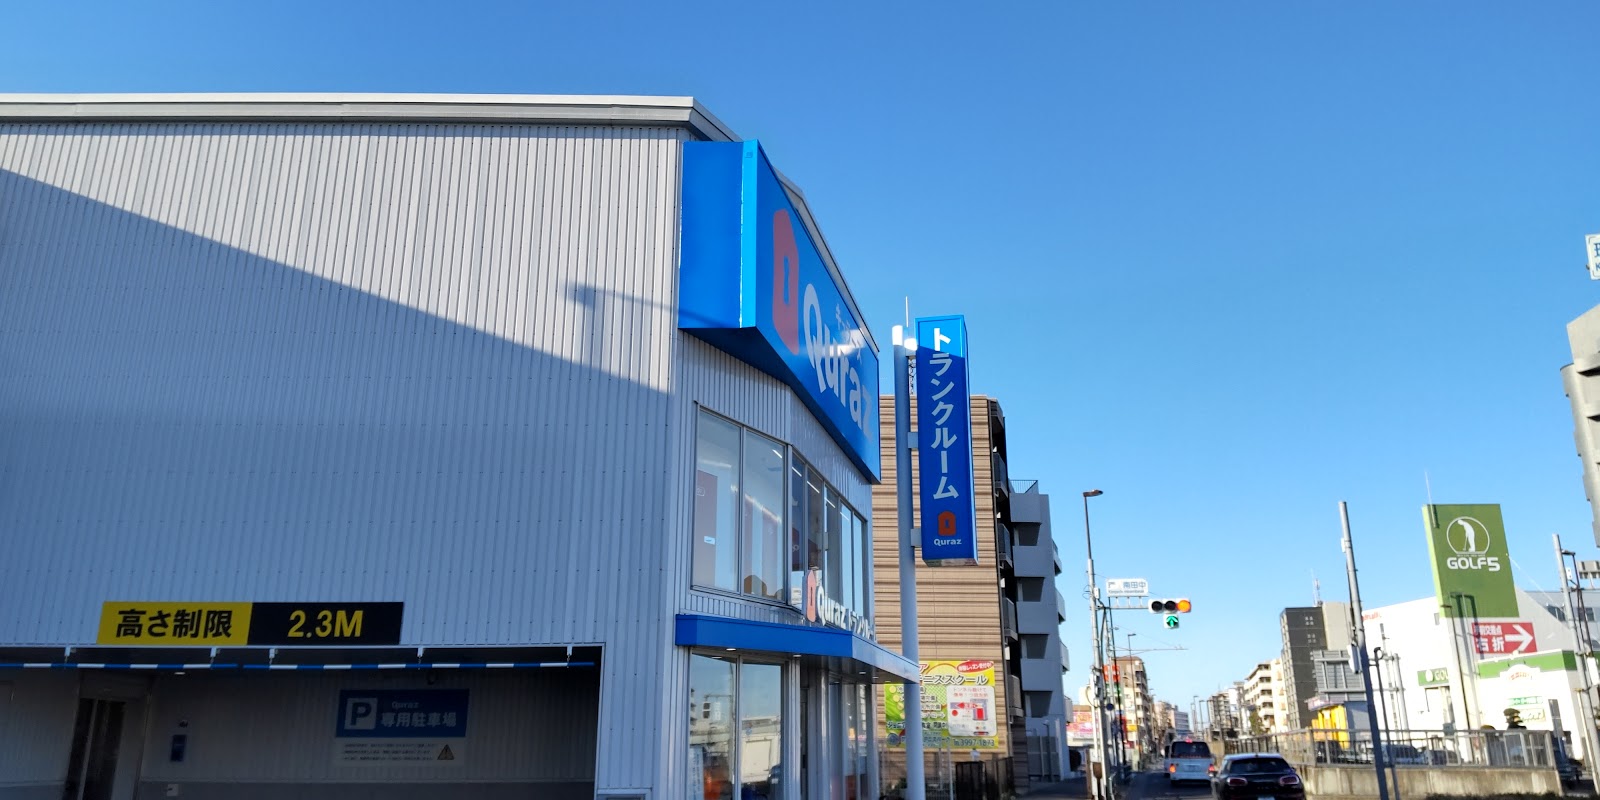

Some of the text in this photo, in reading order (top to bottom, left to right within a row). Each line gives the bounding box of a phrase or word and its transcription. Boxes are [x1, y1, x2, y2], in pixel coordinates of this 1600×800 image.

[803, 283, 873, 444] Quraz
[929, 327, 960, 500] トランクルーム
[933, 538, 962, 547] Quraz
[1446, 556, 1501, 572] GOLF5
[817, 585, 846, 629] Quraz
[115, 609, 364, 638] 高さ制限 2.3M
[349, 701, 372, 726] P
[381, 711, 457, 728] 専用駐車場
